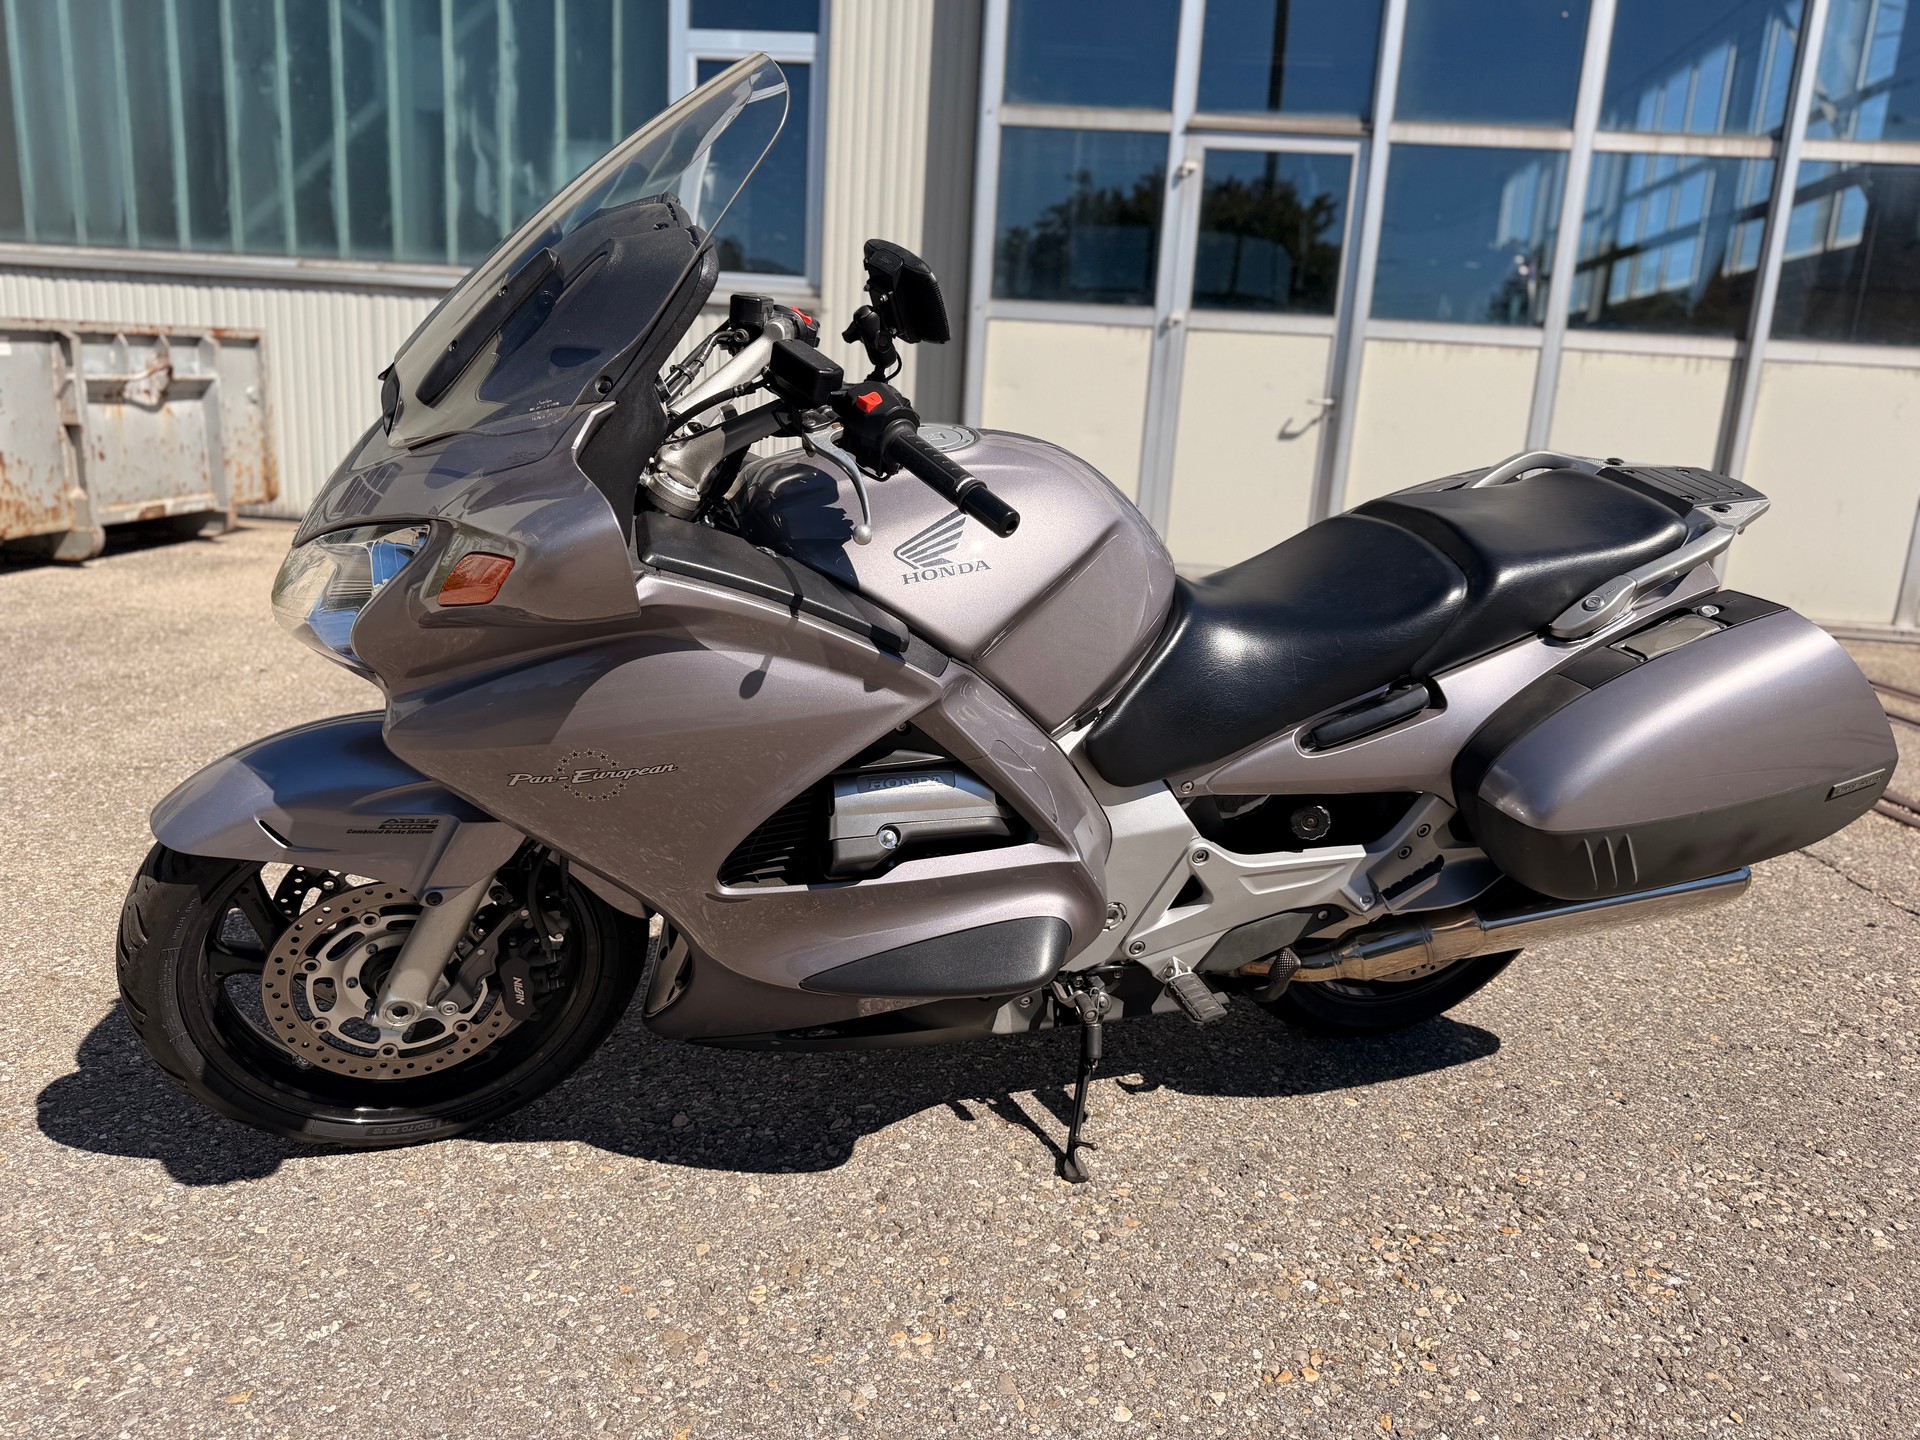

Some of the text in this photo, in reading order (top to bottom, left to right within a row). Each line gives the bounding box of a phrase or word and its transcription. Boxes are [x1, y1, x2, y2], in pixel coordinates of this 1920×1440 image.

[902, 560, 992, 585] HONDA
[507, 762, 678, 786] Pan-European
[868, 776, 945, 790] HONDA
